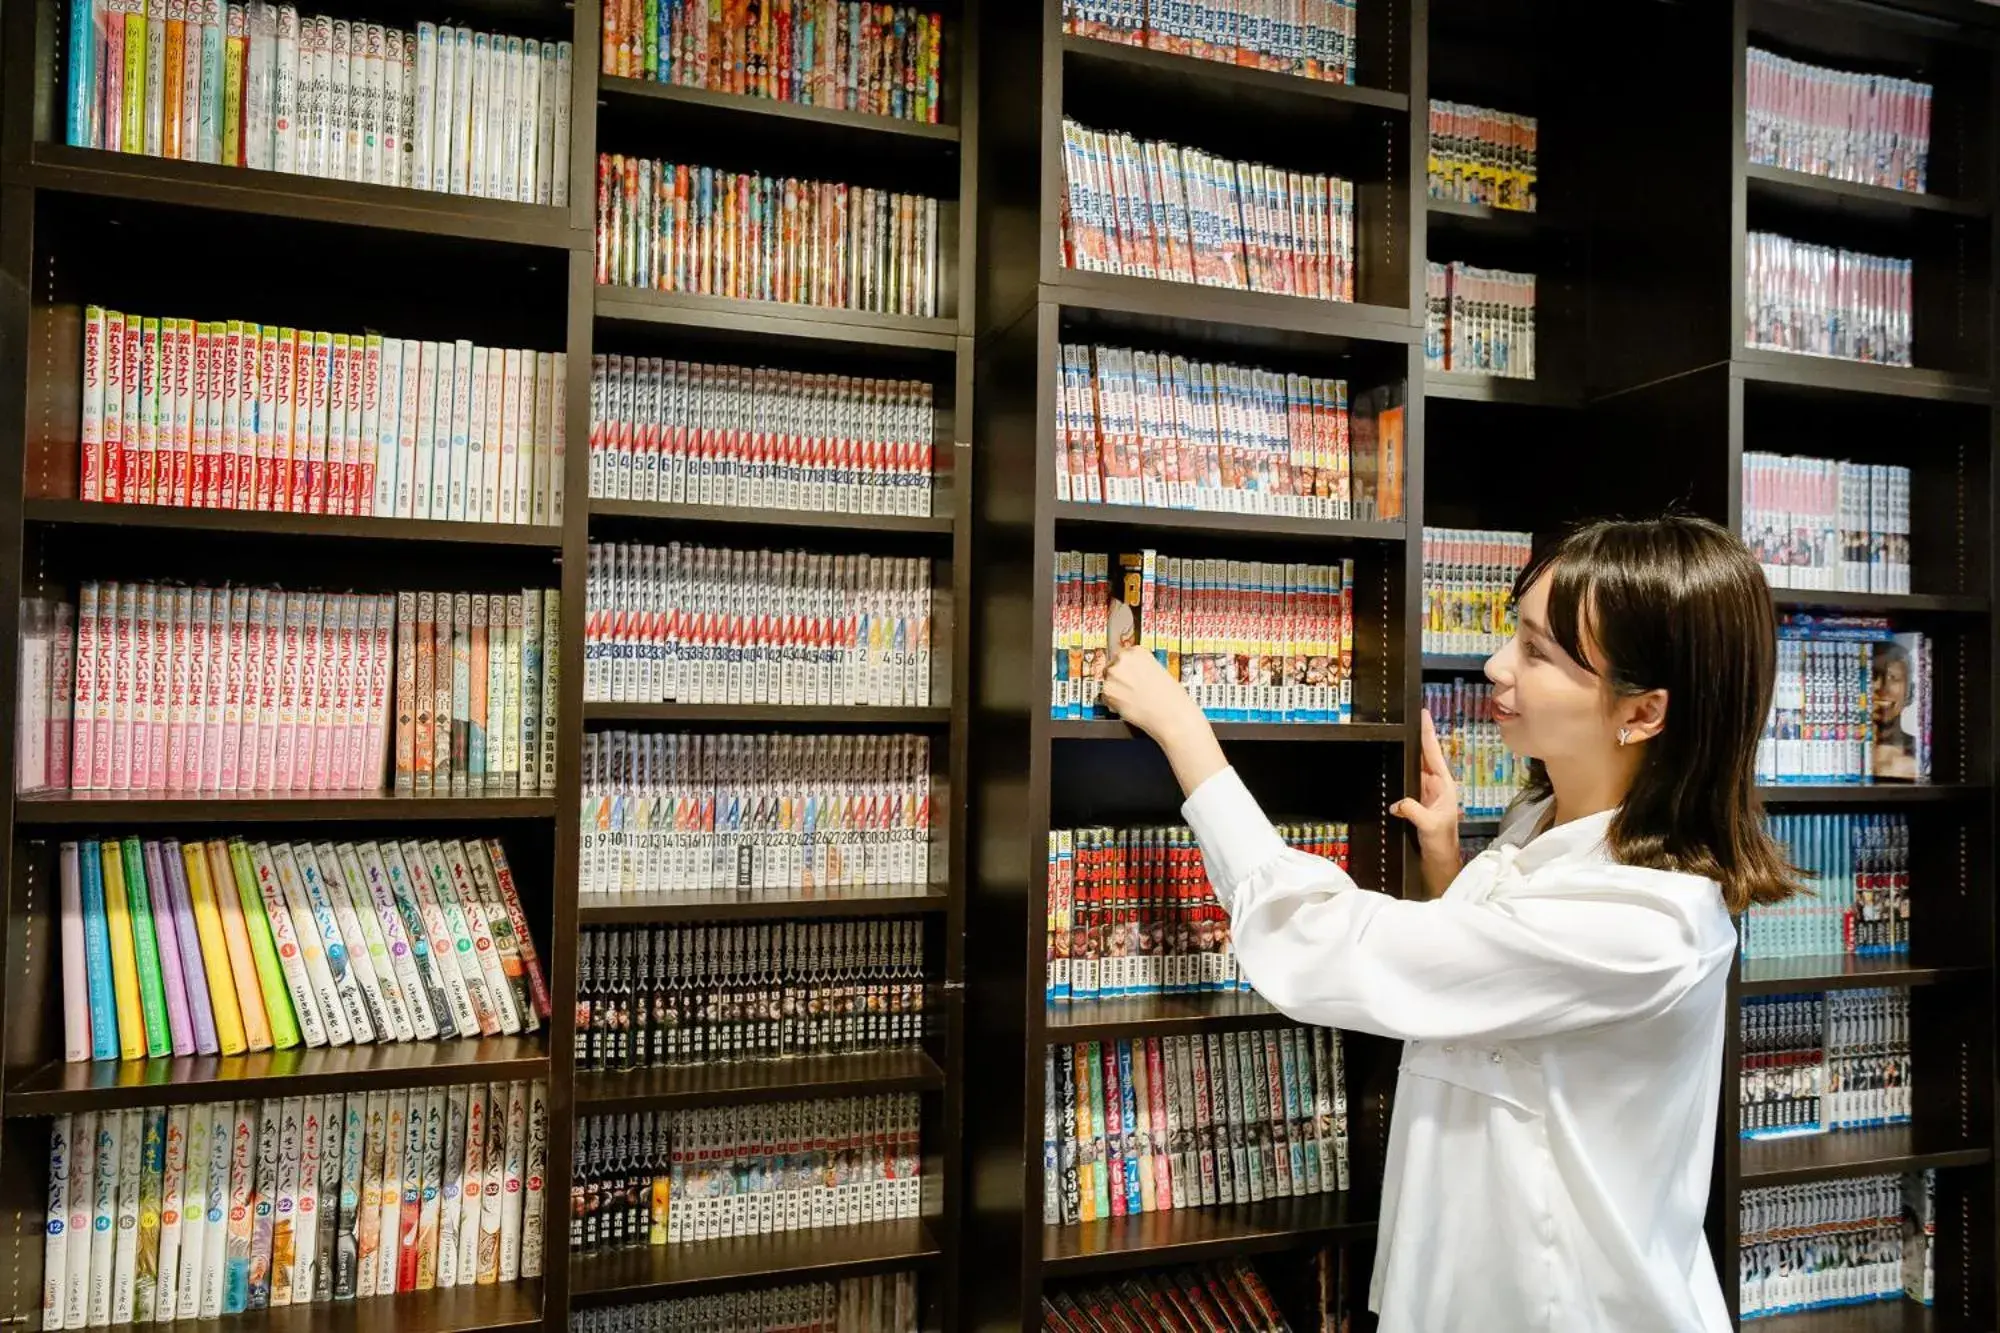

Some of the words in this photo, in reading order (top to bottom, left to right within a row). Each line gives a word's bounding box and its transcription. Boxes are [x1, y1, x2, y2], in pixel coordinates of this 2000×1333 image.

[593, 455, 600, 468] 1
[608, 454, 616, 467] 3
[620, 455, 629, 468] 4
[635, 457, 644, 470] 5
[648, 457, 656, 469] 2
[662, 458, 670, 471] 6
[676, 459, 682, 472] 7
[689, 461, 697, 474] 8
[703, 462, 711, 475] 9
[848, 652, 853, 662] 1
[859, 649, 866, 662] 2
[883, 652, 889, 664] 4
[896, 653, 902, 665] 5
[908, 652, 915, 665] 6
[921, 651, 927, 662] 7
[585, 836, 592, 848] 8
[598, 835, 605, 847] 9
[662, 835, 672, 847] 14
[607, 932, 619, 994] の巨人
[654, 930, 665, 991] の巨人
[602, 1115, 613, 1173] の巨人
